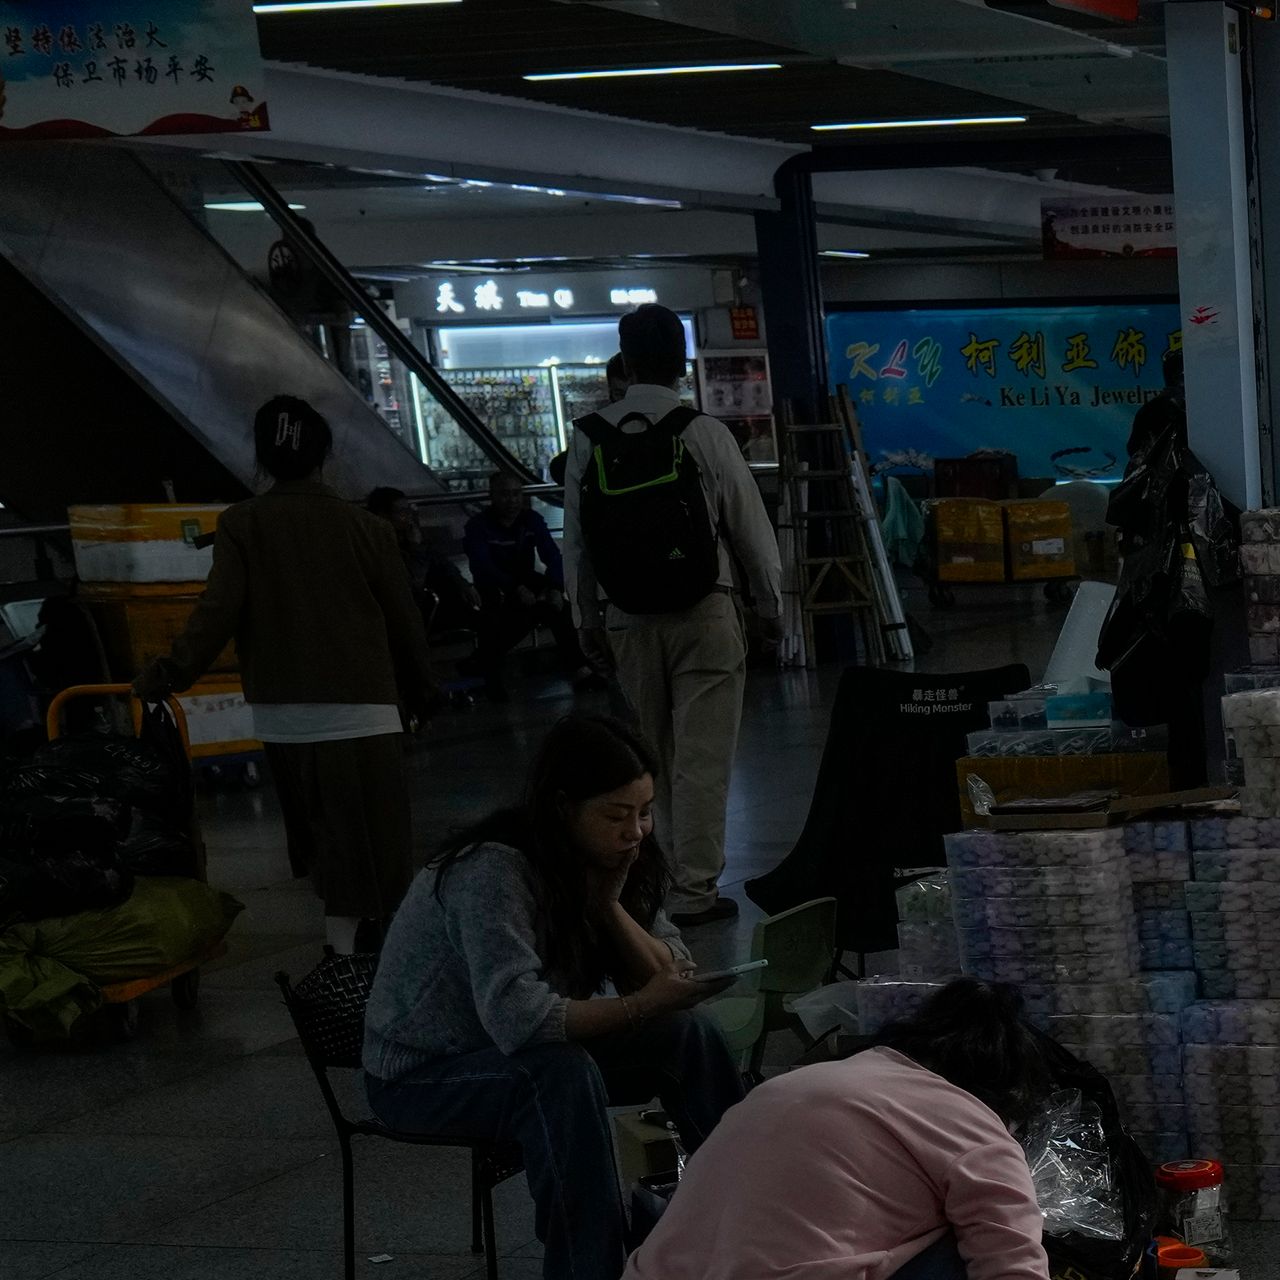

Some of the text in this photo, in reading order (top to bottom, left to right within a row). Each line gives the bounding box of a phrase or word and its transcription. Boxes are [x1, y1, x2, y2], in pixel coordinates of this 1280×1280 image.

[53, 54, 216, 89] 保卫市场平安
[1000, 387, 1025, 407] Ke
[1031, 386, 1050, 407] Li
[1055, 386, 1081, 407] Ya
[911, 688, 959, 702] 暴走怪兽
[899, 702, 974, 715] Hiking Monster
